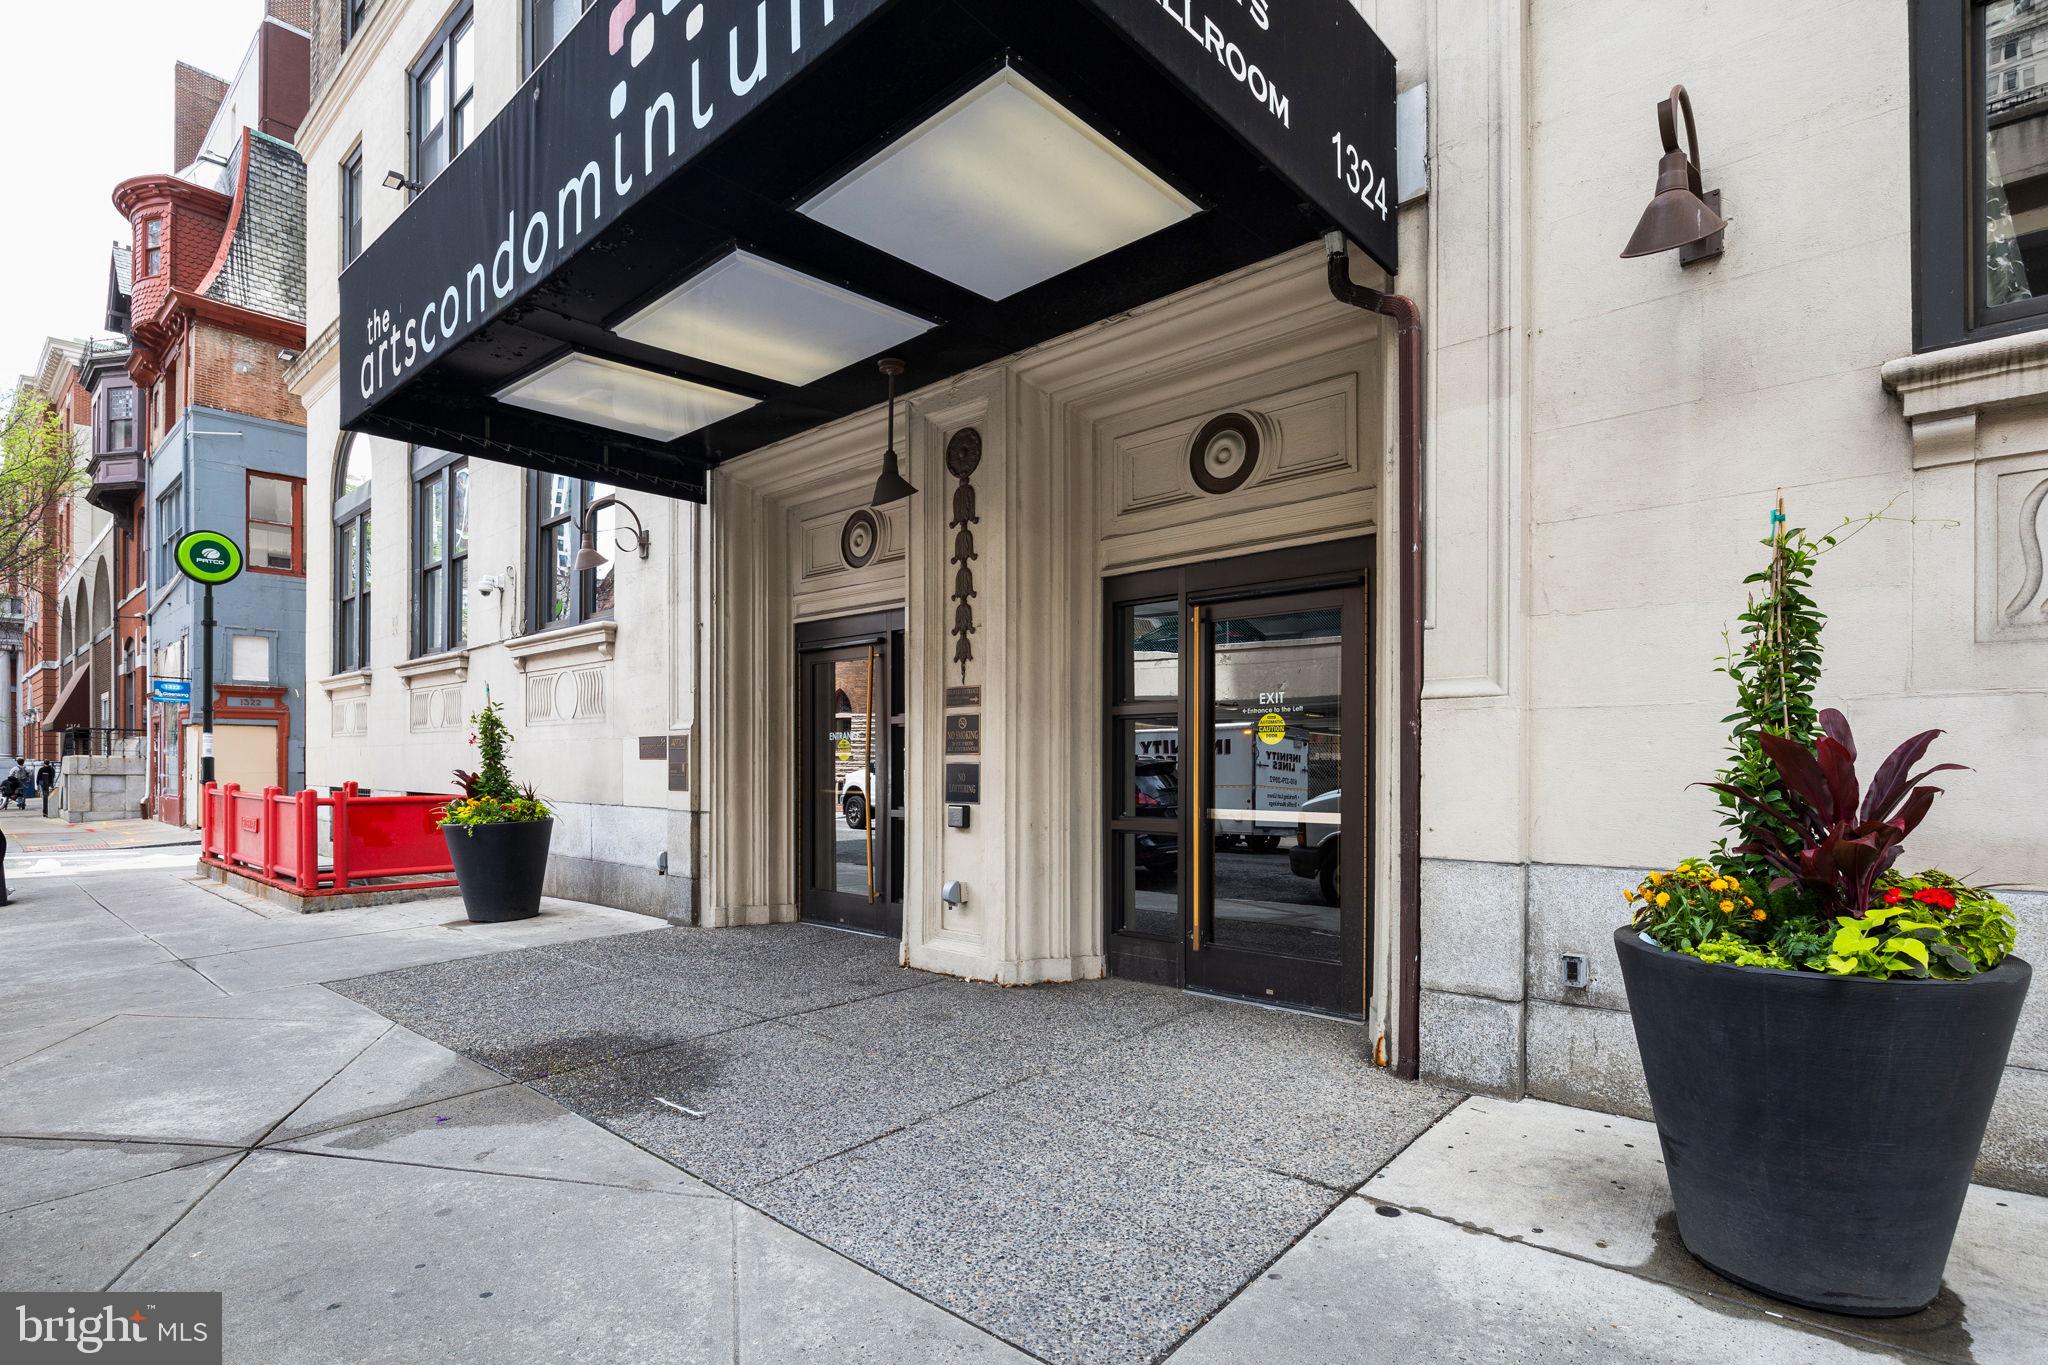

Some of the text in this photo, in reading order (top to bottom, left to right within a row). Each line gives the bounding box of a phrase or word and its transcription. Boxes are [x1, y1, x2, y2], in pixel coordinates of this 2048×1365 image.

[1332, 131, 1388, 221] 1324
[367, 309, 390, 345] the
[196, 557, 225, 566] PATCO
[240, 698, 262, 706] 1322
[1259, 692, 1285, 704] EXIT
[1247, 706, 1273, 714] Entrance
[949, 784, 976, 794] LOITERING
